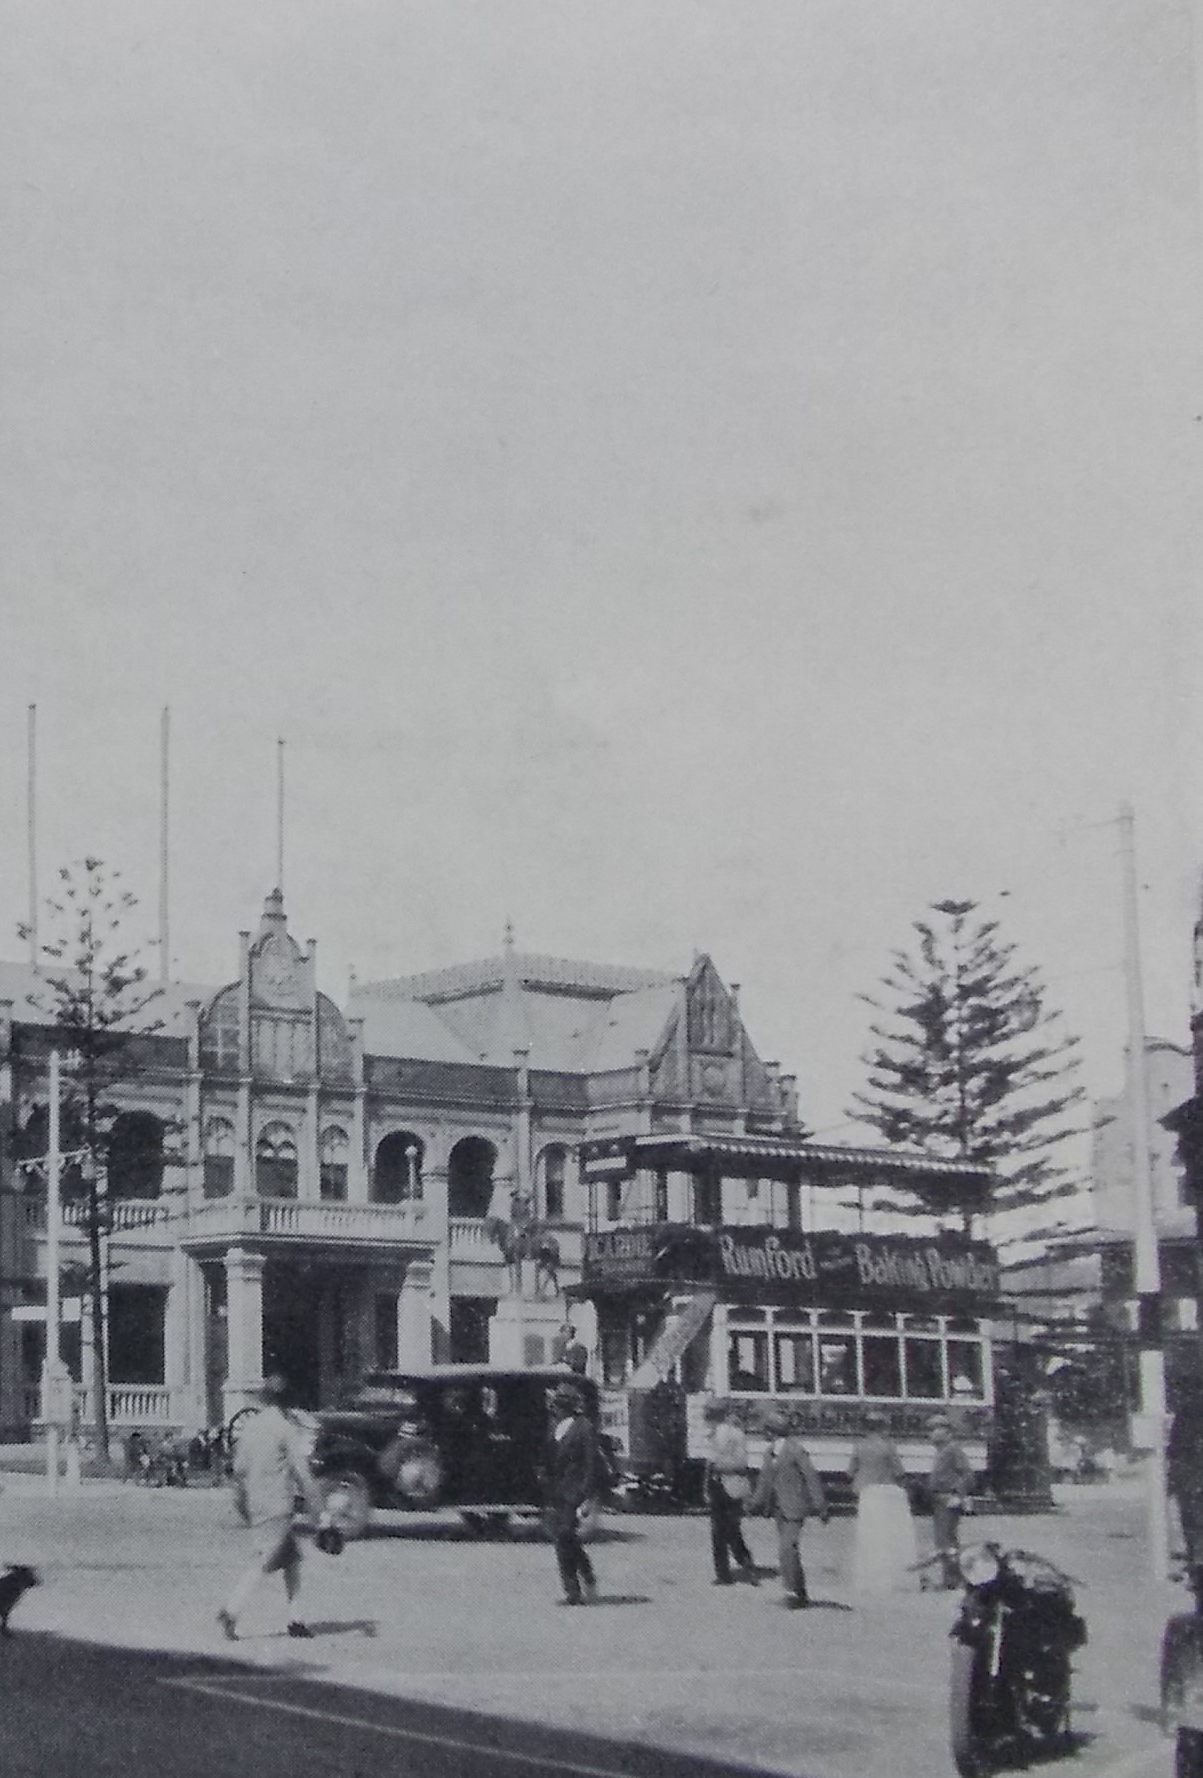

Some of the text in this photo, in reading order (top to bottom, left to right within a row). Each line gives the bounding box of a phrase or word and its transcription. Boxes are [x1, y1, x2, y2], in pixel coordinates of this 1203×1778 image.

[719, 1234, 817, 1281] Rumford
[855, 1243, 929, 1291] Baking
[926, 1247, 997, 1290] Powder
